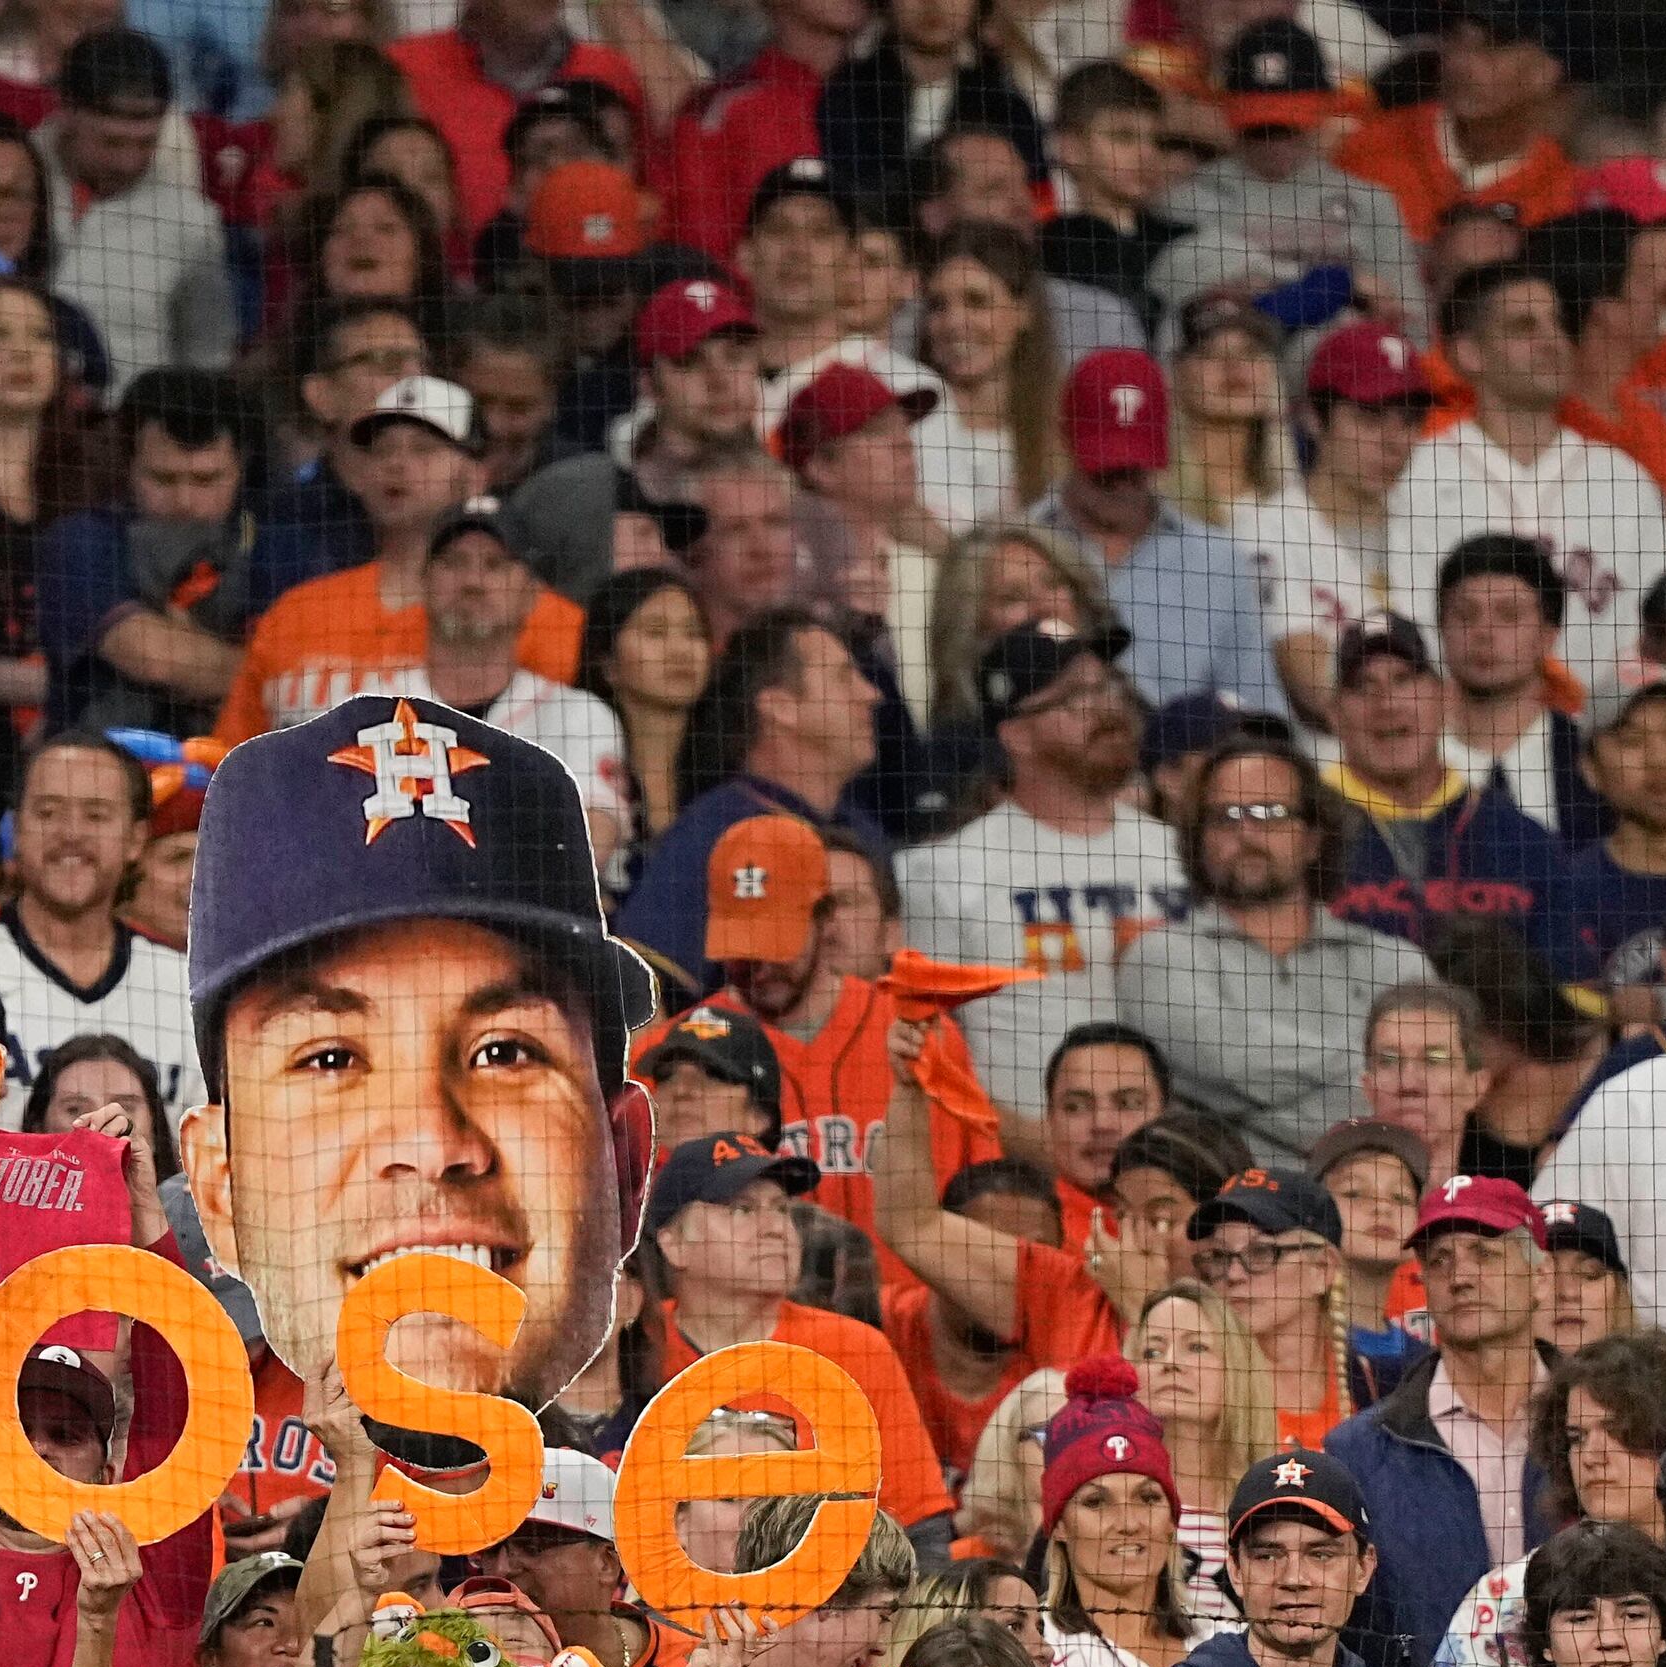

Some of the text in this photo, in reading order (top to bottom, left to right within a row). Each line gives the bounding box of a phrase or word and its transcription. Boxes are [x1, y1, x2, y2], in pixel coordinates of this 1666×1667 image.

[358, 722, 470, 819] H
[1442, 1175, 1473, 1203] P
[15, 1571, 38, 1601] P
